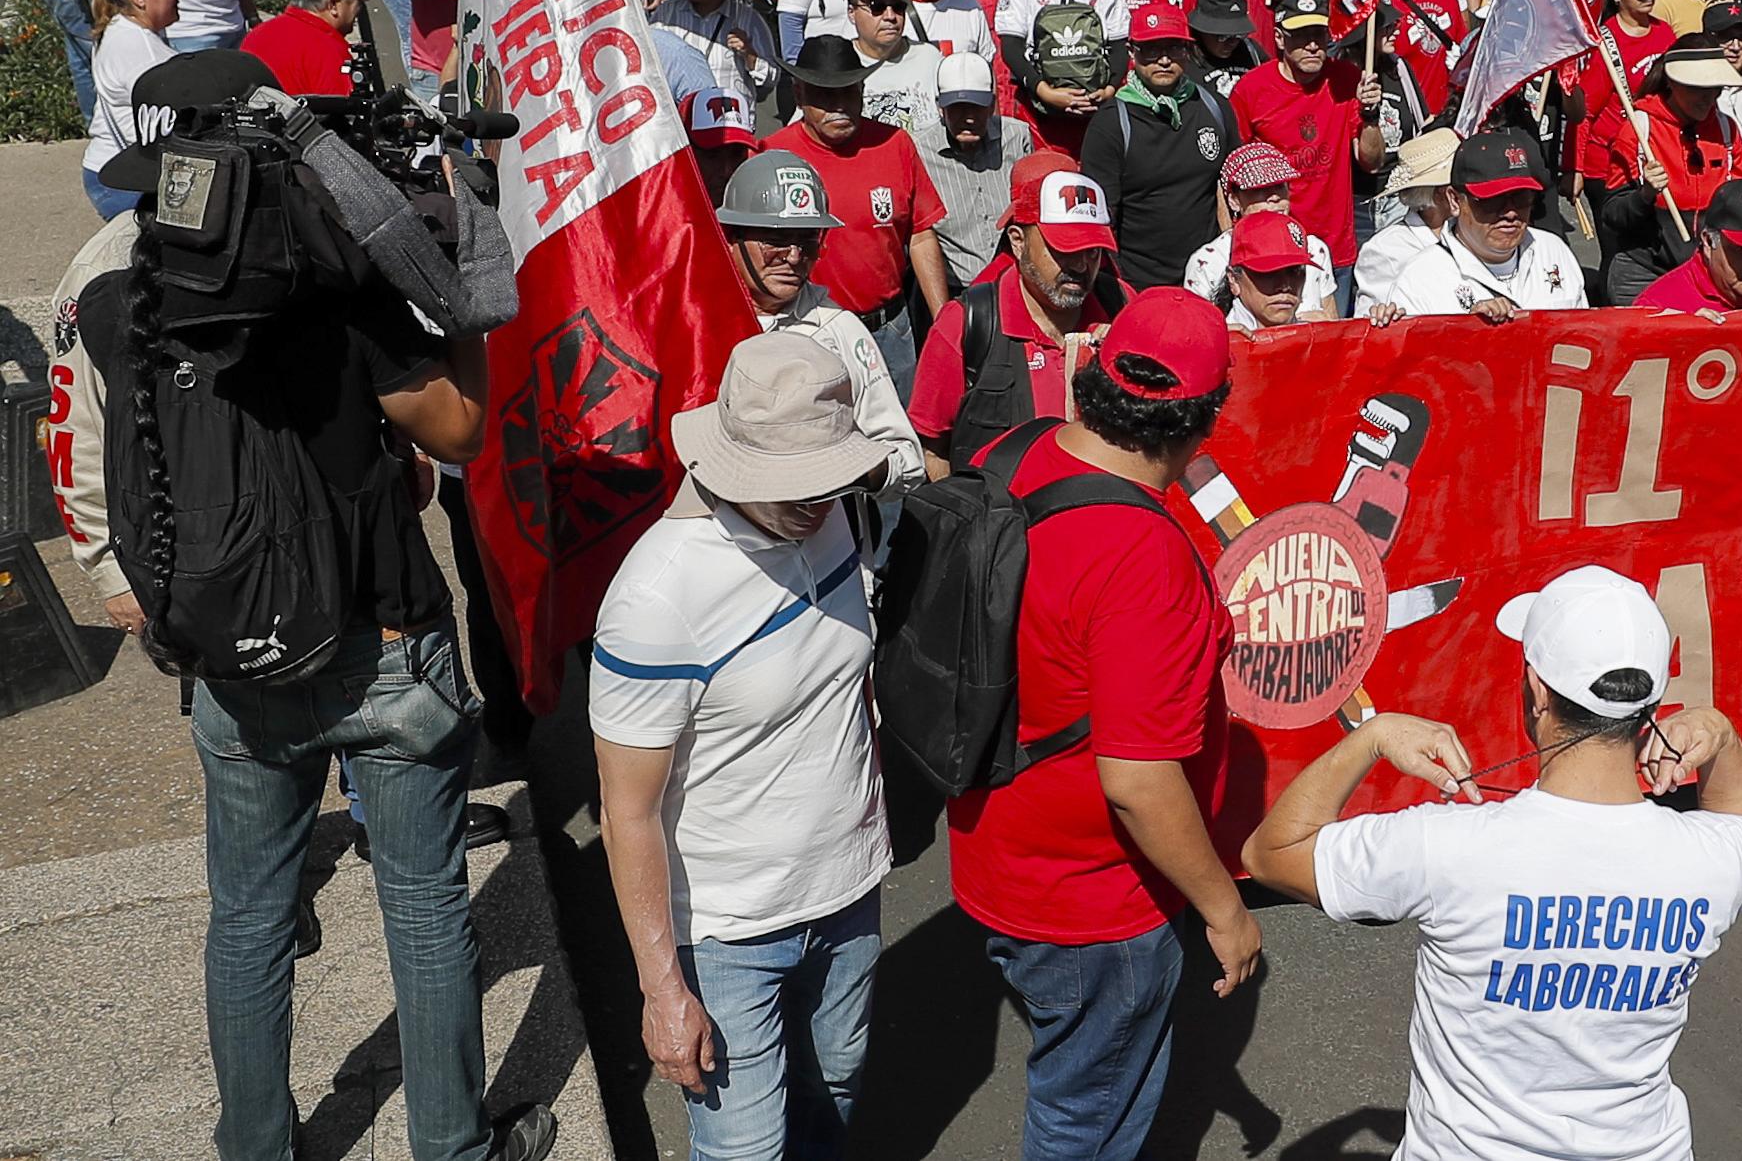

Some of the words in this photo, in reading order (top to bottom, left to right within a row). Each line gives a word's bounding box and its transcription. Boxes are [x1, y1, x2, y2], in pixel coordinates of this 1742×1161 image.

[1051, 44, 1089, 57] adidas
[1227, 532, 1363, 604] NUEVA
[1228, 578, 1365, 644] CENTRAL
[1230, 629, 1363, 704] TRABAJADORES
[1503, 894, 1710, 954] DERECHOS
[1484, 956, 1699, 1013] LABORALES
